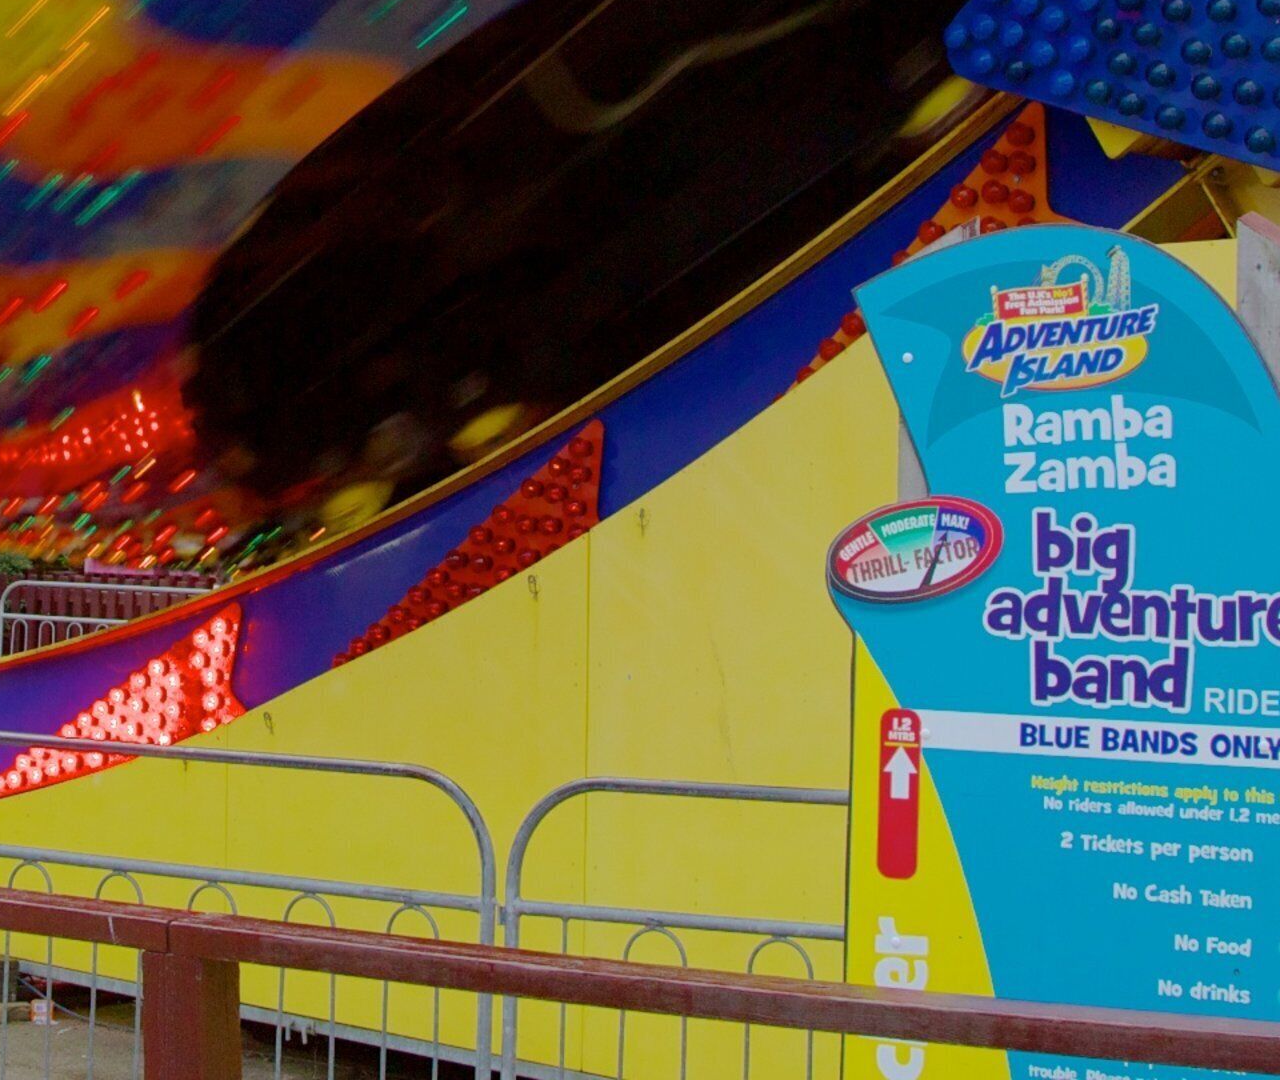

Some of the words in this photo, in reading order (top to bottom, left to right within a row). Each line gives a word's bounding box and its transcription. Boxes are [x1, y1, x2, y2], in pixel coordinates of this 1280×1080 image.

[1005, 300, 1026, 310] Free
[1008, 291, 1026, 301] The
[966, 304, 1158, 371] ADVENTURE
[1001, 346, 1125, 397] ISLAND
[1003, 395, 1173, 446] Ramba
[1004, 443, 1176, 493] Zamba
[881, 513, 936, 537] MODERATE
[941, 513, 970, 529] MAX!
[839, 531, 876, 560] GENTLE
[1033, 507, 1134, 595] big
[1031, 638, 1195, 713] band
[1204, 687, 1280, 716] RIDE
[1020, 723, 1090, 749] BLUE
[1101, 727, 1198, 756] BANDS
[1031, 775, 1078, 796] Height
[1083, 780, 1168, 798] restrictions
[1174, 785, 1218, 805] apply
[1223, 787, 1240, 802] to
[1245, 787, 1275, 804] this
[1044, 796, 1063, 811] No
[1068, 798, 1112, 815] riders
[1117, 801, 1174, 819] allowed
[1179, 807, 1223, 822] under
[1060, 831, 1074, 849] 2
[1080, 834, 1144, 855] Tickets
[1150, 842, 1181, 861] per
[1189, 843, 1254, 863] person
[1113, 883, 1138, 900] No
[1145, 884, 1192, 906] Cash
[1200, 890, 1253, 910] Taken
[1174, 934, 1199, 952] No
[1207, 937, 1252, 957] Food
[859, 916, 929, 1080] cer
[1158, 979, 1183, 997] No
[1190, 981, 1251, 1004] drinks
